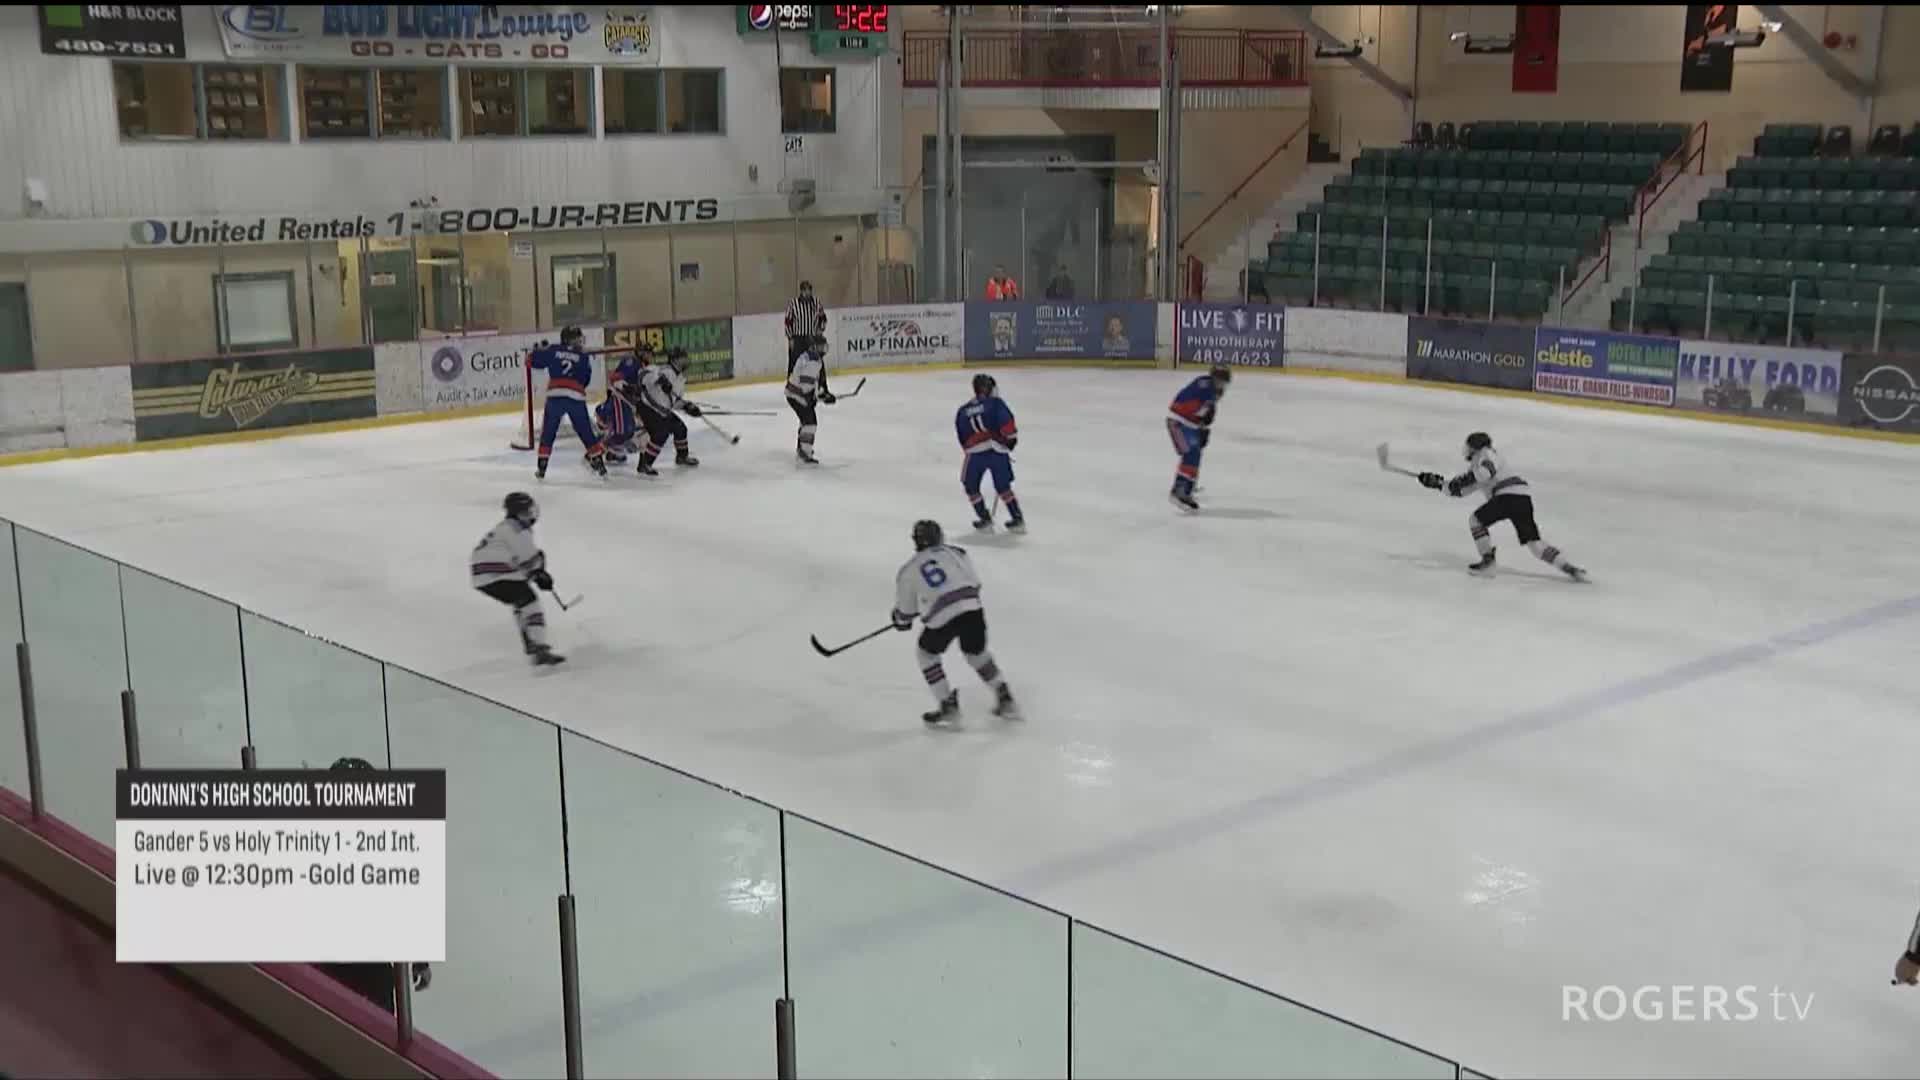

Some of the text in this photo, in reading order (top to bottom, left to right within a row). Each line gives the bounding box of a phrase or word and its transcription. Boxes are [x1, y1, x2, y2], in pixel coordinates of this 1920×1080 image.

[87, 5, 177, 21] H&R BLOCK
[323, 5, 388, 36] BUD
[774, 5, 812, 23] pepsi
[351, 41, 394, 57] GO
[425, 42, 503, 58] CATS
[531, 44, 569, 58] GO
[169, 219, 265, 245] United
[279, 216, 375, 241] Rentals
[1181, 309, 1283, 332] LIVE FIT
[847, 335, 949, 352] NLP FINANCE
[1187, 335, 1276, 348] PHYSIOTHERAPY
[470, 351, 521, 372] Grant
[1192, 348, 1271, 366] 489-4623
[1433, 348, 1525, 368] MARATHON GOLD
[1680, 353, 1756, 383] KELLY
[1765, 360, 1838, 392] FORD
[921, 559, 946, 587] 6
